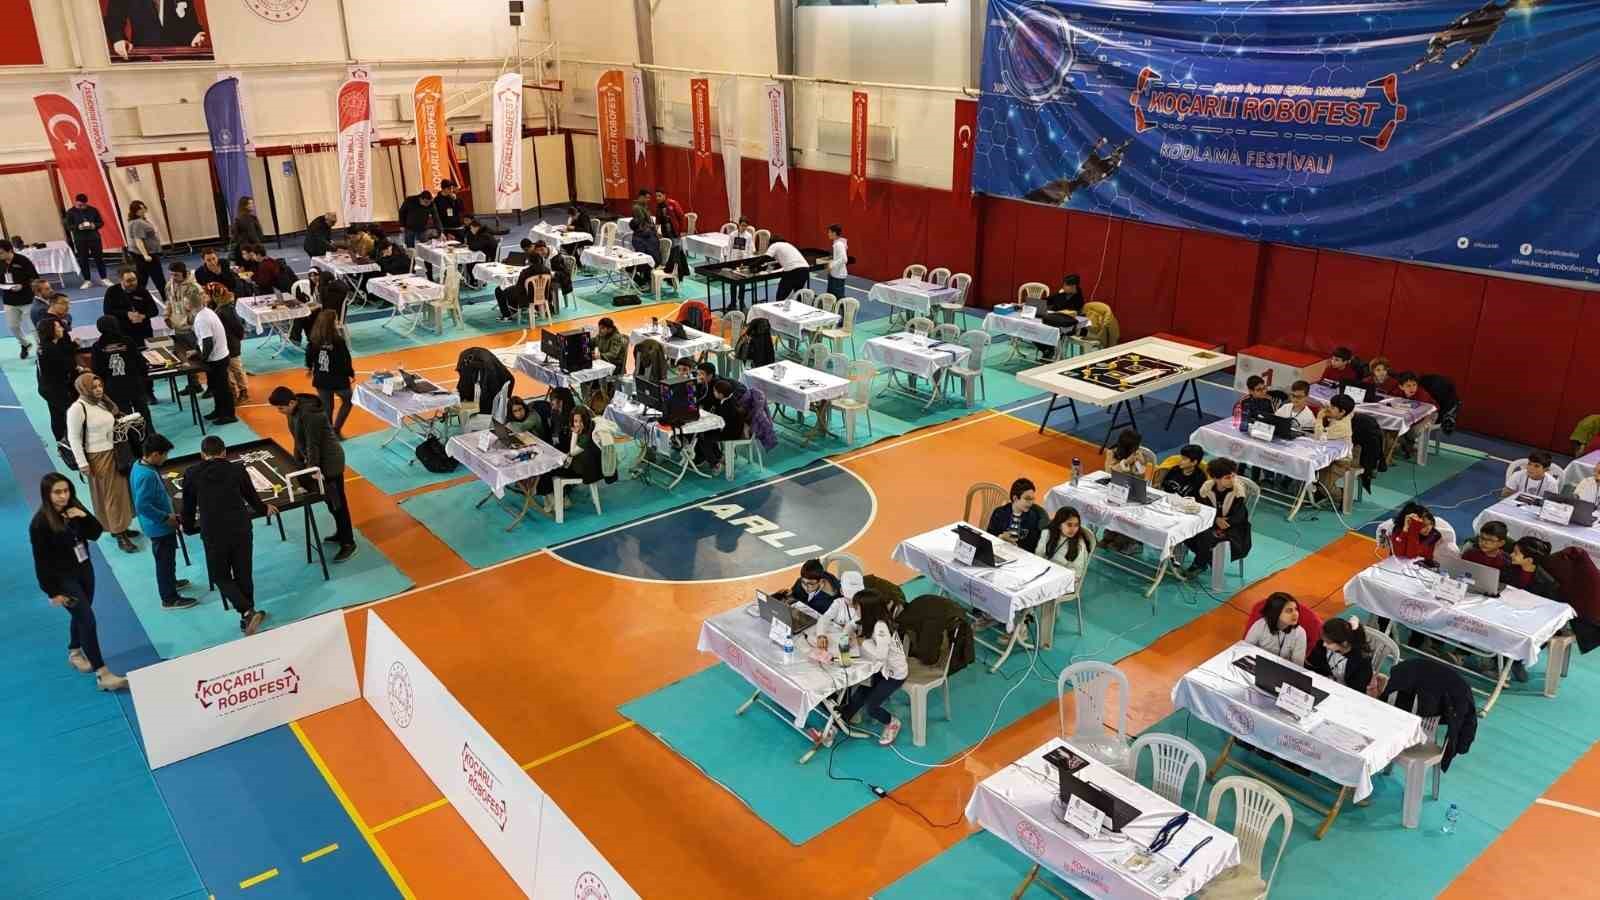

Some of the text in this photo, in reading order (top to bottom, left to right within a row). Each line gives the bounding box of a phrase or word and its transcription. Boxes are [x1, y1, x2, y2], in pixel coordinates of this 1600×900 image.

[1242, 98, 1381, 127] ROBOFEST
[1159, 143, 1241, 166] KODLAMA
[1262, 368, 1273, 386] 1
[203, 668, 264, 698] KOÇARLI
[218, 675, 292, 710] ROBOFEST
[463, 751, 494, 790] KOÇARLI
[468, 773, 505, 817] ROBOFEST
